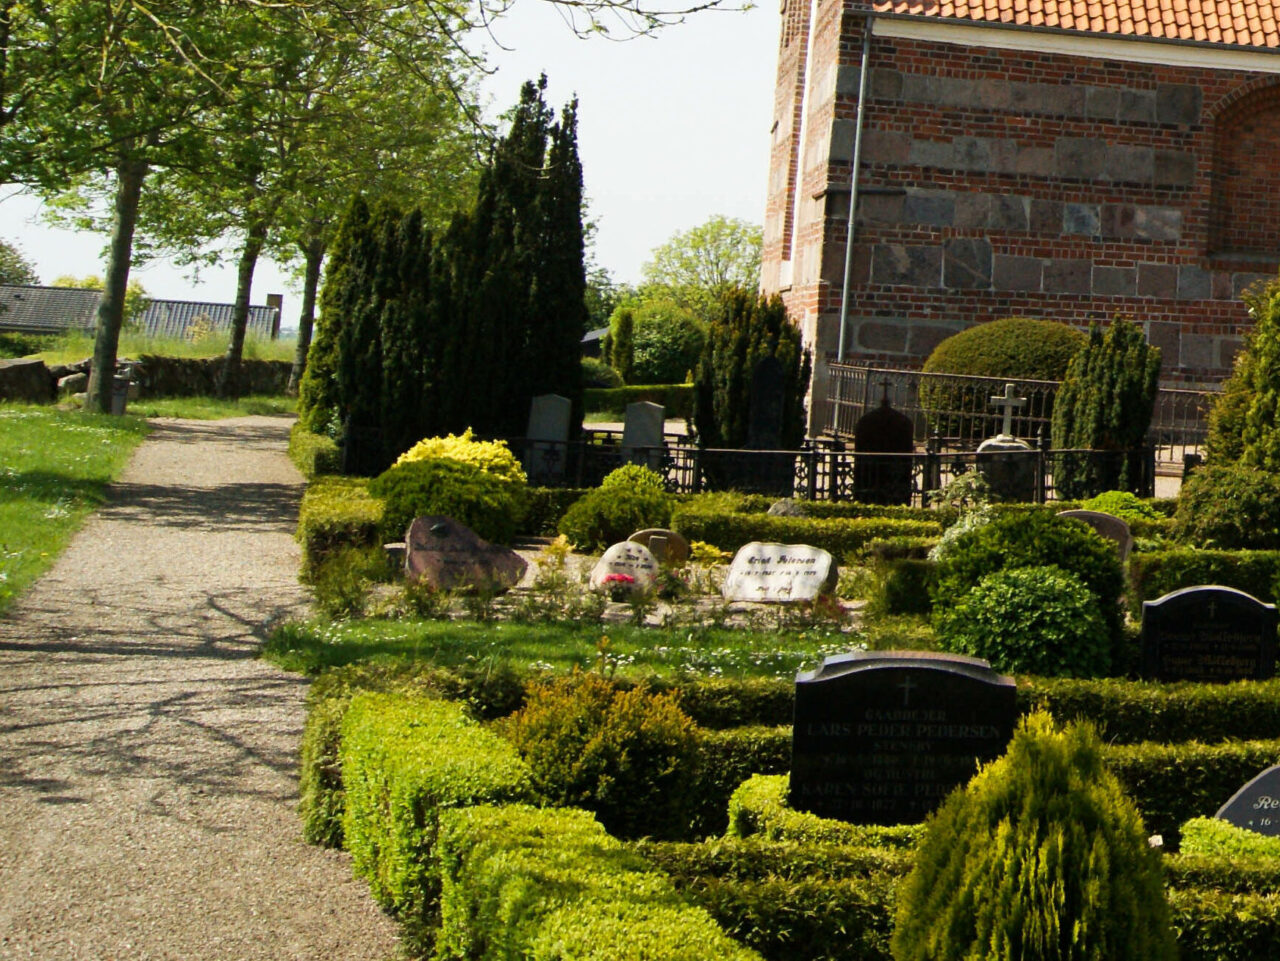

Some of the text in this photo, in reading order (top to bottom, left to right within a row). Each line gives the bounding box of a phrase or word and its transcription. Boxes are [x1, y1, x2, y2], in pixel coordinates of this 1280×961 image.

[807, 723, 1000, 739] LARS PEDER PEDERSEN
